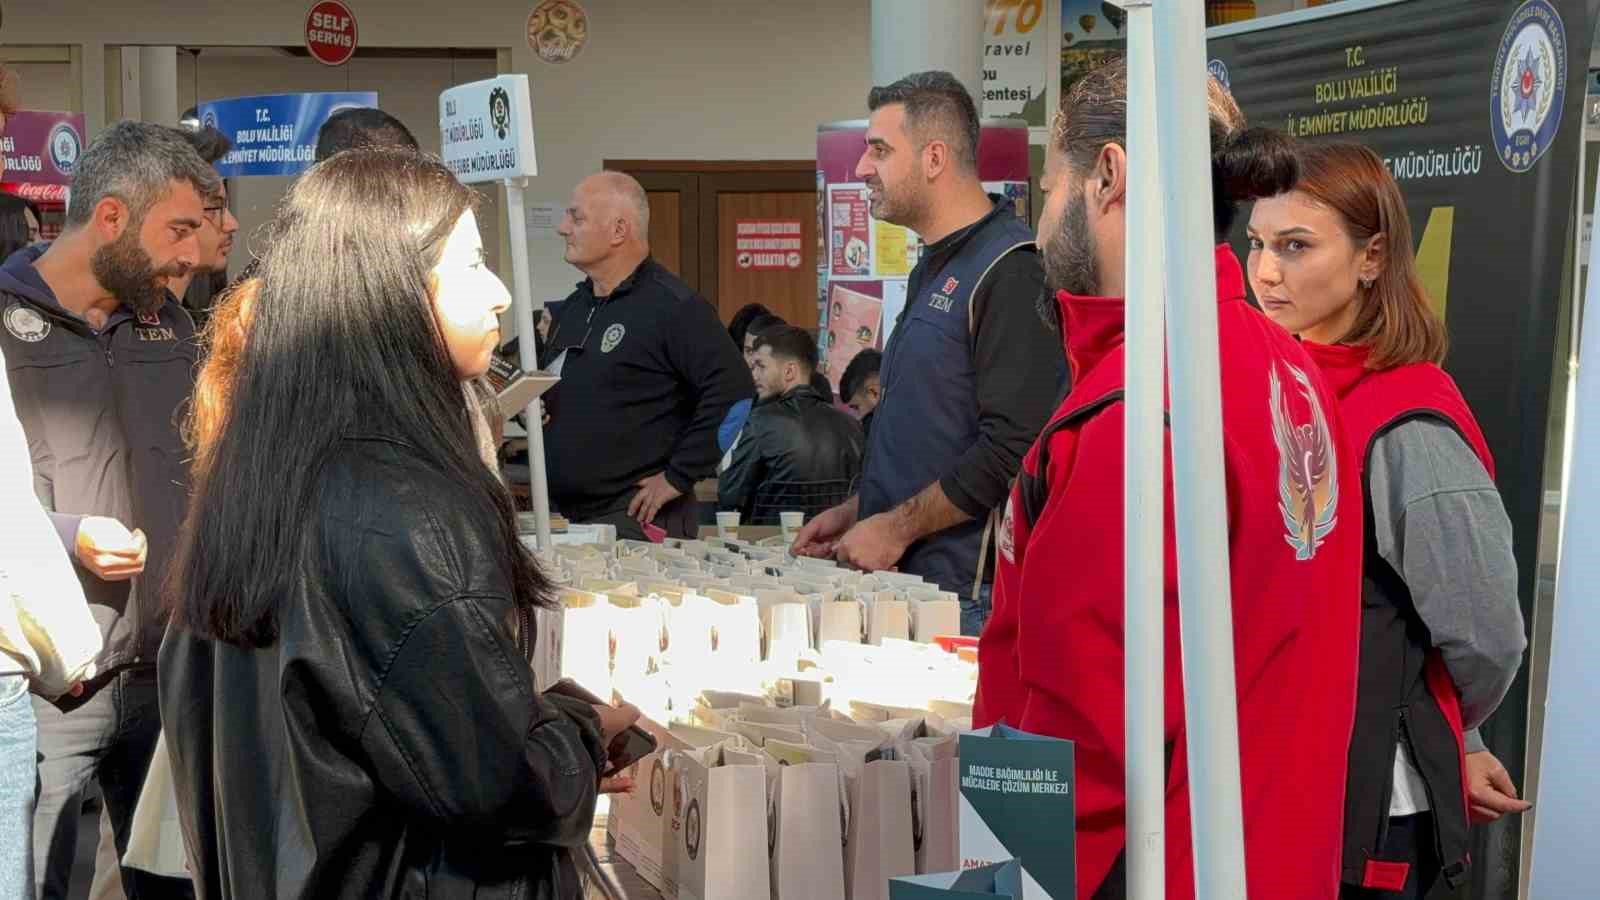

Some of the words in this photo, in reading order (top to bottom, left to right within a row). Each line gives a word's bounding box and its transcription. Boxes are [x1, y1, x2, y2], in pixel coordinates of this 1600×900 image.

[312, 12, 350, 31] SELF
[984, 41, 1030, 56] ravel
[1345, 46, 1365, 67] T.C.
[1315, 78, 1347, 104] BOLU
[1348, 66, 1398, 99] VALİLİĞİ
[1287, 113, 1297, 137] İL
[1299, 110, 1347, 137] EMNİYET
[1349, 97, 1428, 131] MÜDÜRLÜĞÜ
[236, 129, 256, 143] BOLU
[256, 123, 294, 142] VALİLİĞİ
[1394, 145, 1482, 180] MÜDÜRLÜĞÜ
[928, 293, 954, 312] TEM
[135, 327, 174, 342] TEM
[969, 765, 995, 778] MADDE
[1045, 769, 1058, 781] İLE
[1002, 780, 1030, 794] ÇÖZÜM
[1032, 782, 1069, 794] MERKEZİ
